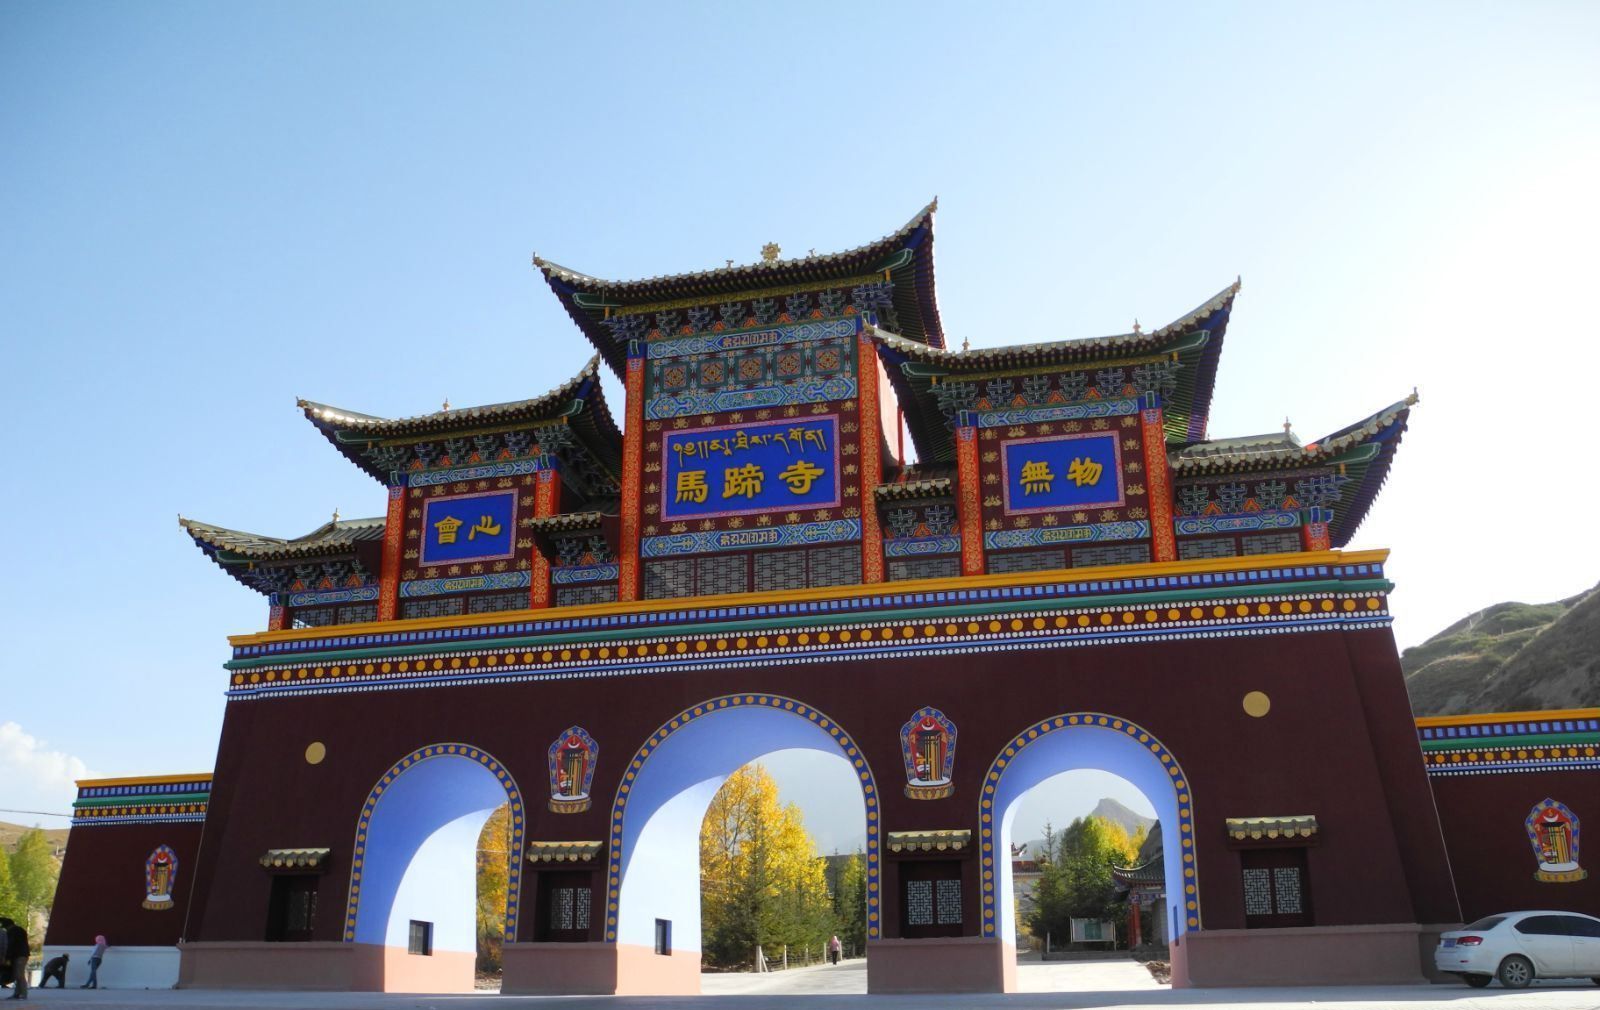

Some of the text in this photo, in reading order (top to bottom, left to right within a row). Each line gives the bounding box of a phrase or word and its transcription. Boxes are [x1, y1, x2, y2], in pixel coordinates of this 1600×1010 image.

[674, 460, 825, 504] 馬蹄寺
[1019, 456, 1103, 496] 無物
